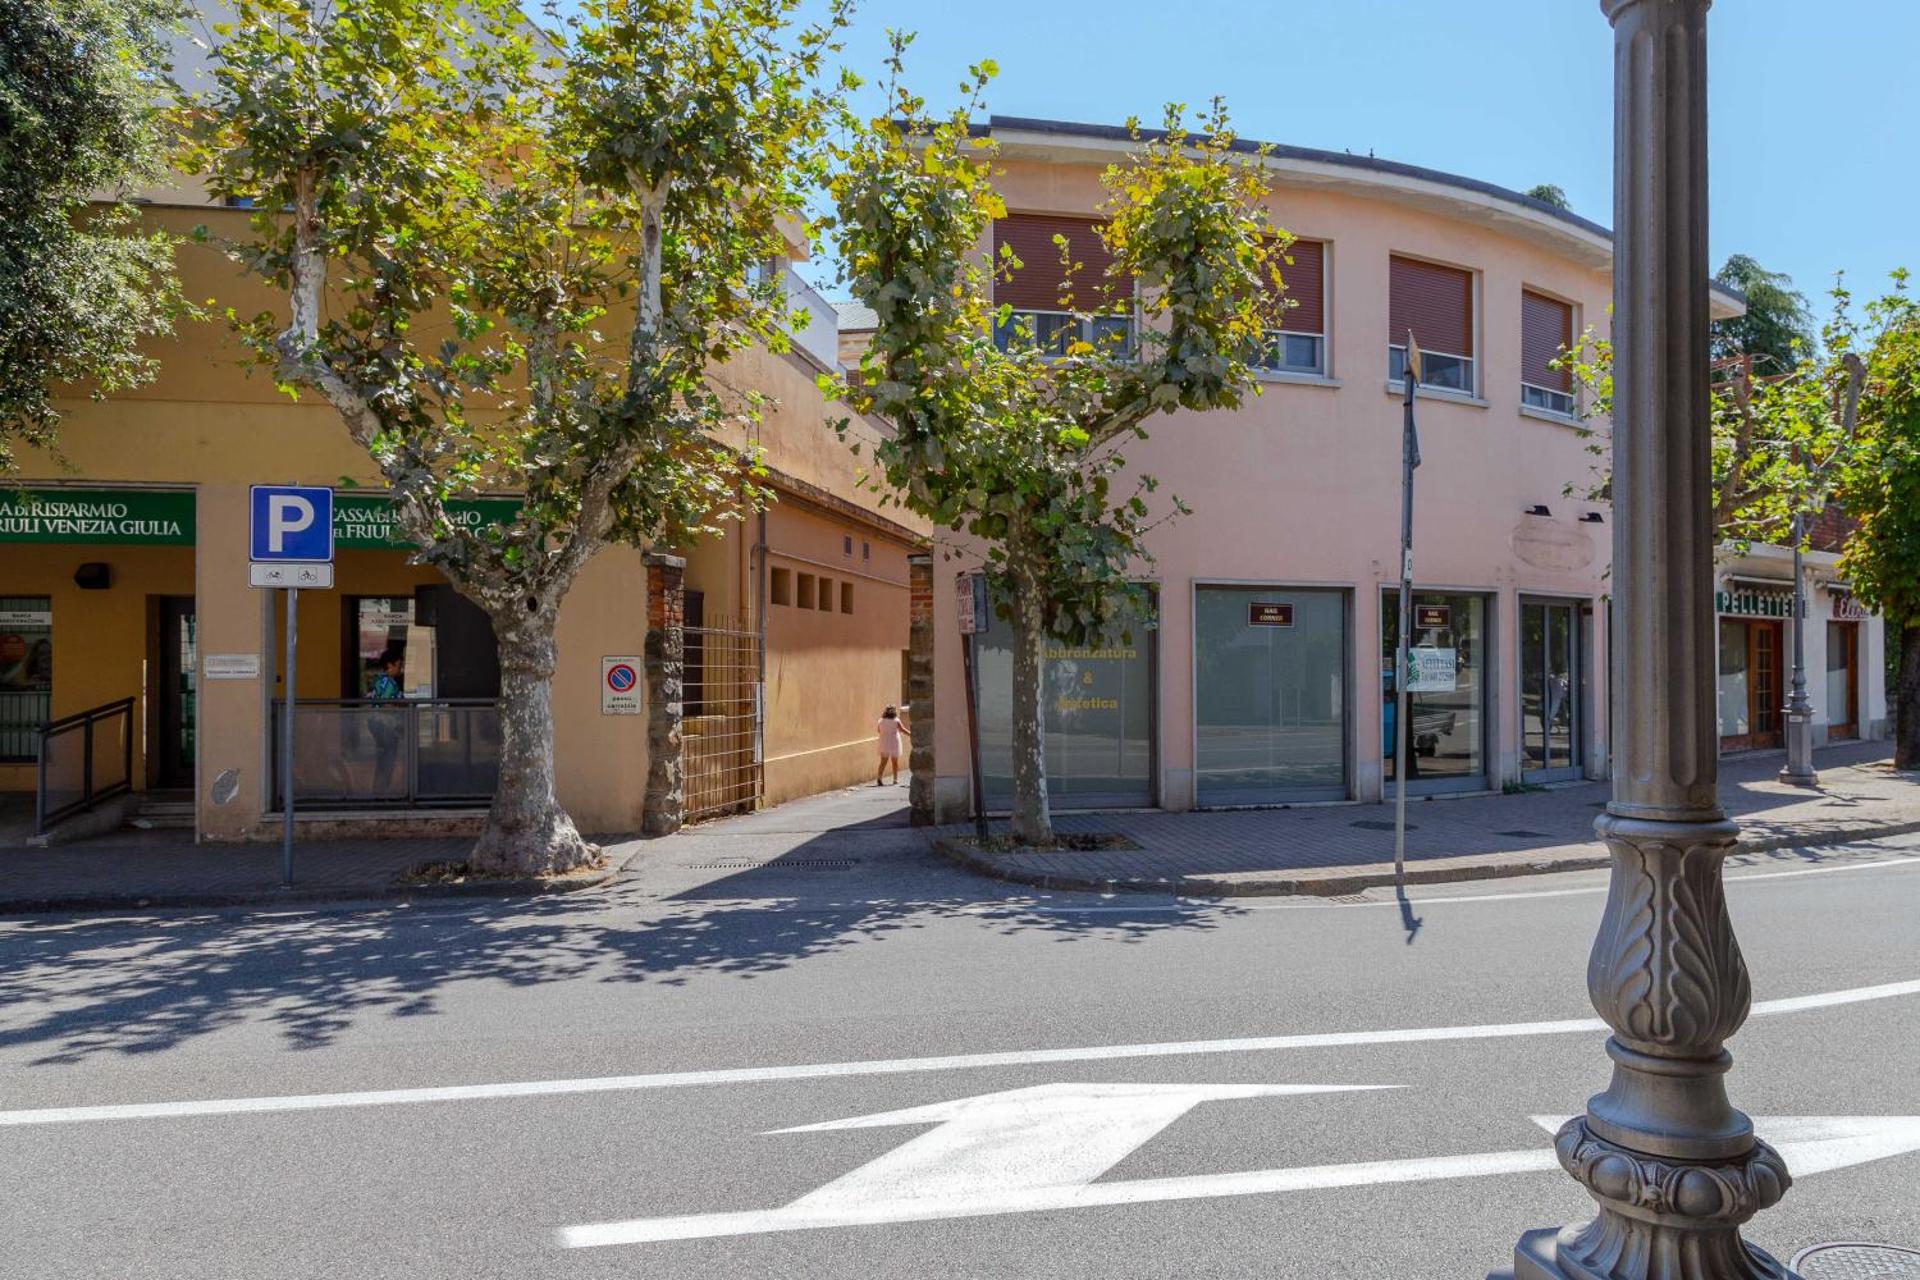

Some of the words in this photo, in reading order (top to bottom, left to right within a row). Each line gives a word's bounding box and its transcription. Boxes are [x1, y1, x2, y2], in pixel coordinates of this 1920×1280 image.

[31, 502, 127, 518] RISPARMIO
[333, 507, 375, 522] ASSA
[43, 518, 118, 535] VENEZIA
[119, 520, 182, 536] GIULIA
[269, 495, 314, 553] P
[333, 528, 345, 538] EL
[1083, 671, 1094, 685] &
